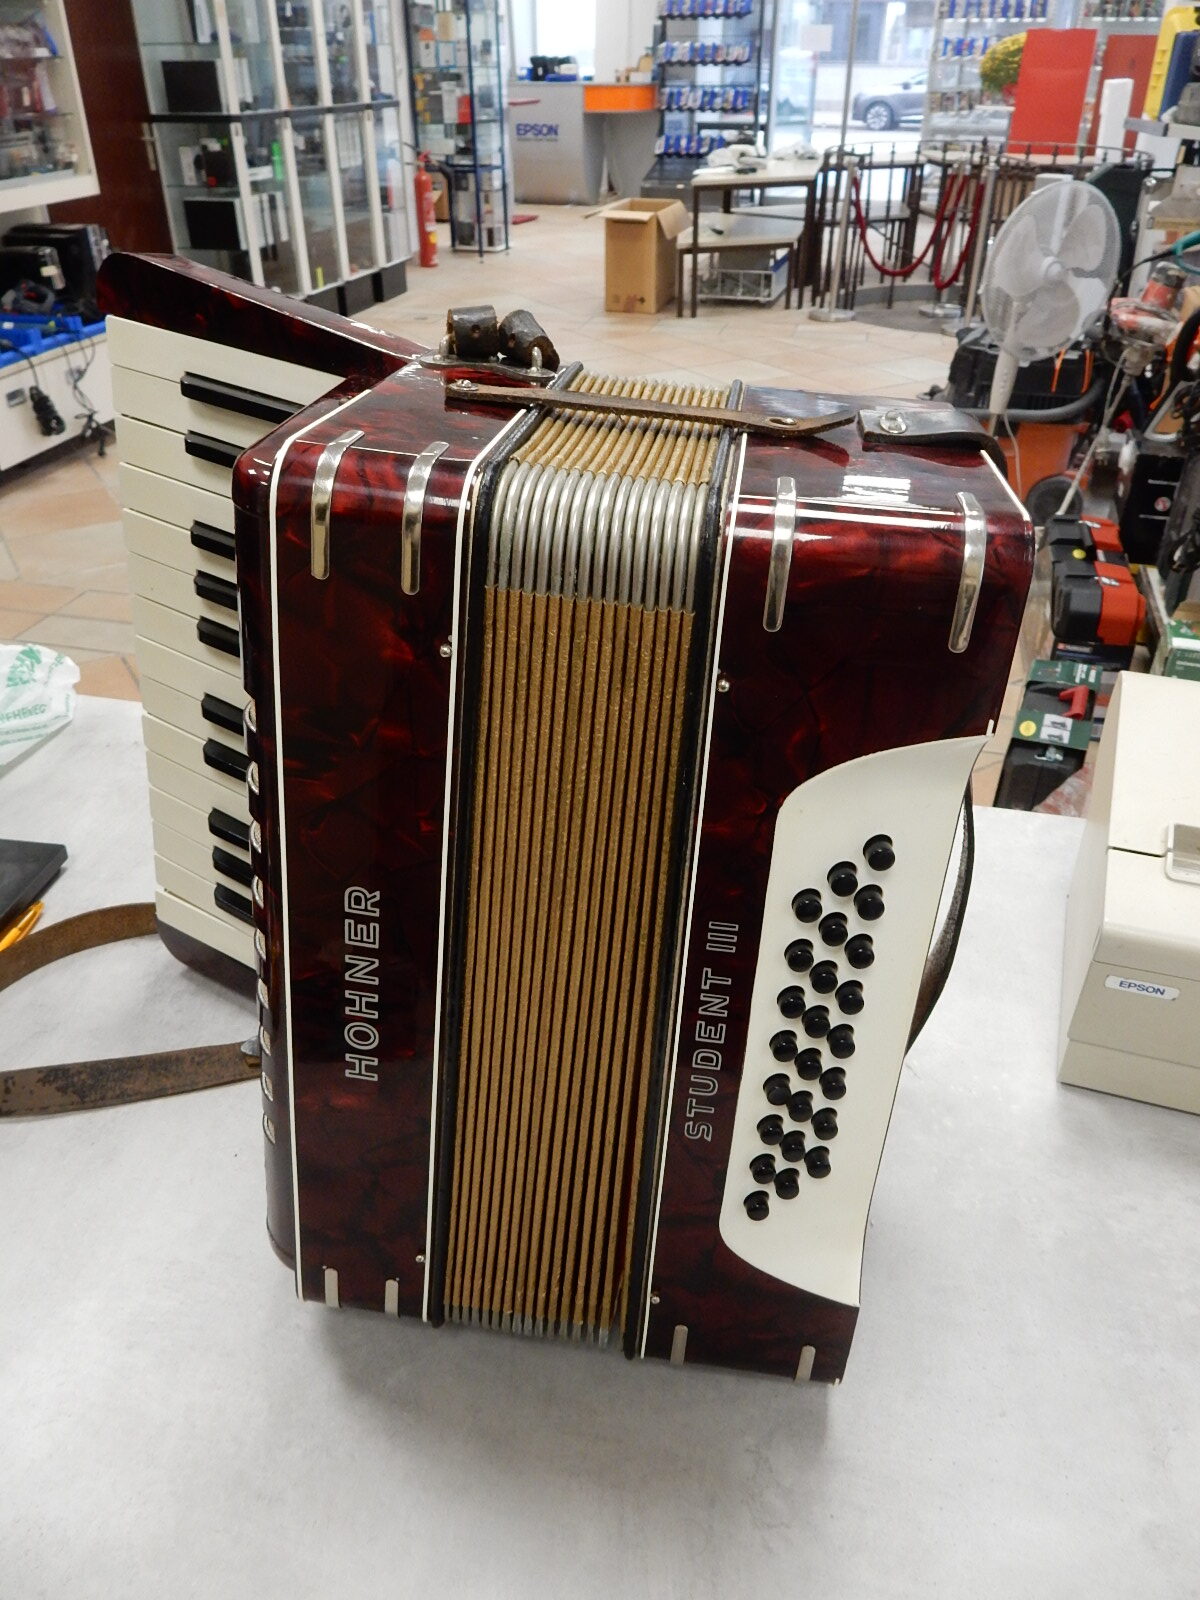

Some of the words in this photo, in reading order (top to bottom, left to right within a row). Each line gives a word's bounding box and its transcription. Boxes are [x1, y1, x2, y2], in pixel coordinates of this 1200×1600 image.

[516, 123, 559, 136] EPSON
[706, 921, 739, 953] III
[344, 886, 381, 1082] HOHNER
[1119, 980, 1166, 996] EPSON
[684, 967, 732, 1142] STUDENT
